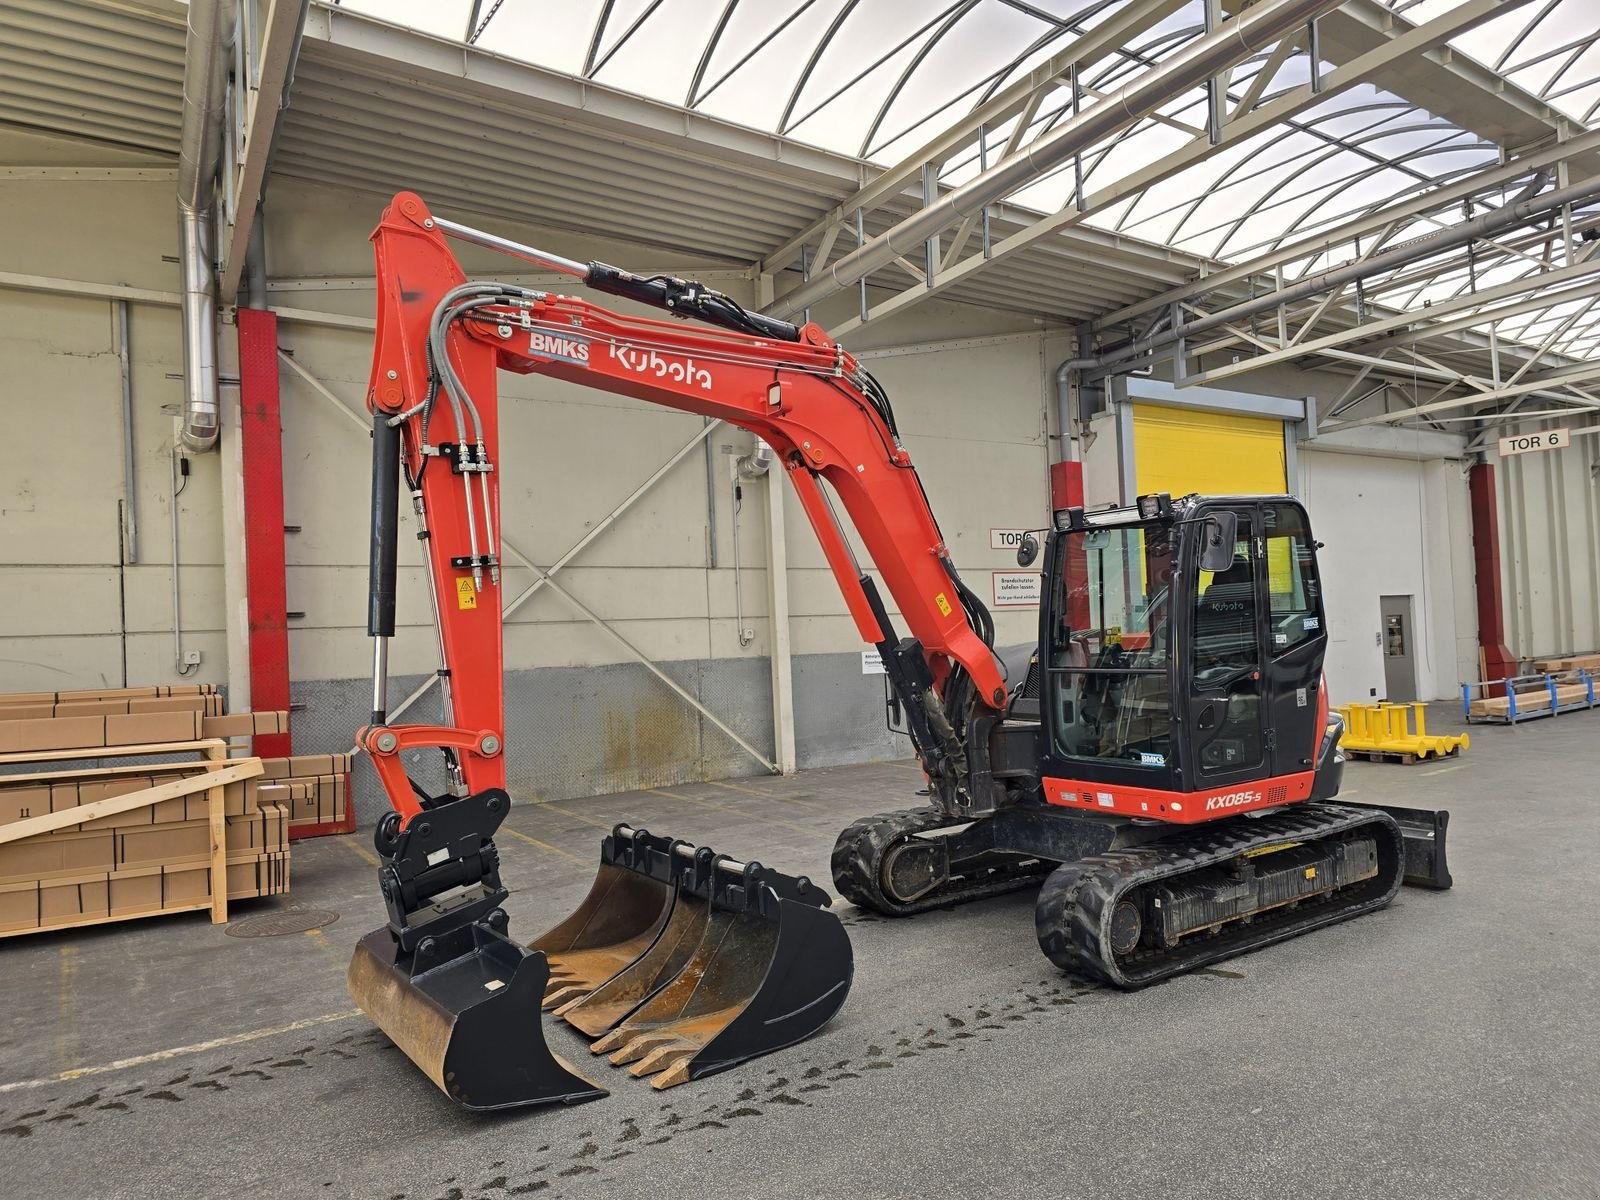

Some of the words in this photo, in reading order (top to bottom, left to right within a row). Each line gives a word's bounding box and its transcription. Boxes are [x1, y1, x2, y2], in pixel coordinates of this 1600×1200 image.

[530, 332, 589, 361] BMKS
[609, 337, 712, 390] Kubota
[1508, 436, 1541, 451] TOR
[1548, 433, 1559, 445] 6
[999, 533, 1022, 545] TOR
[1212, 601, 1244, 611] Kubota
[1141, 755, 1165, 764] BMKS
[1206, 791, 1262, 811] KX085-5
